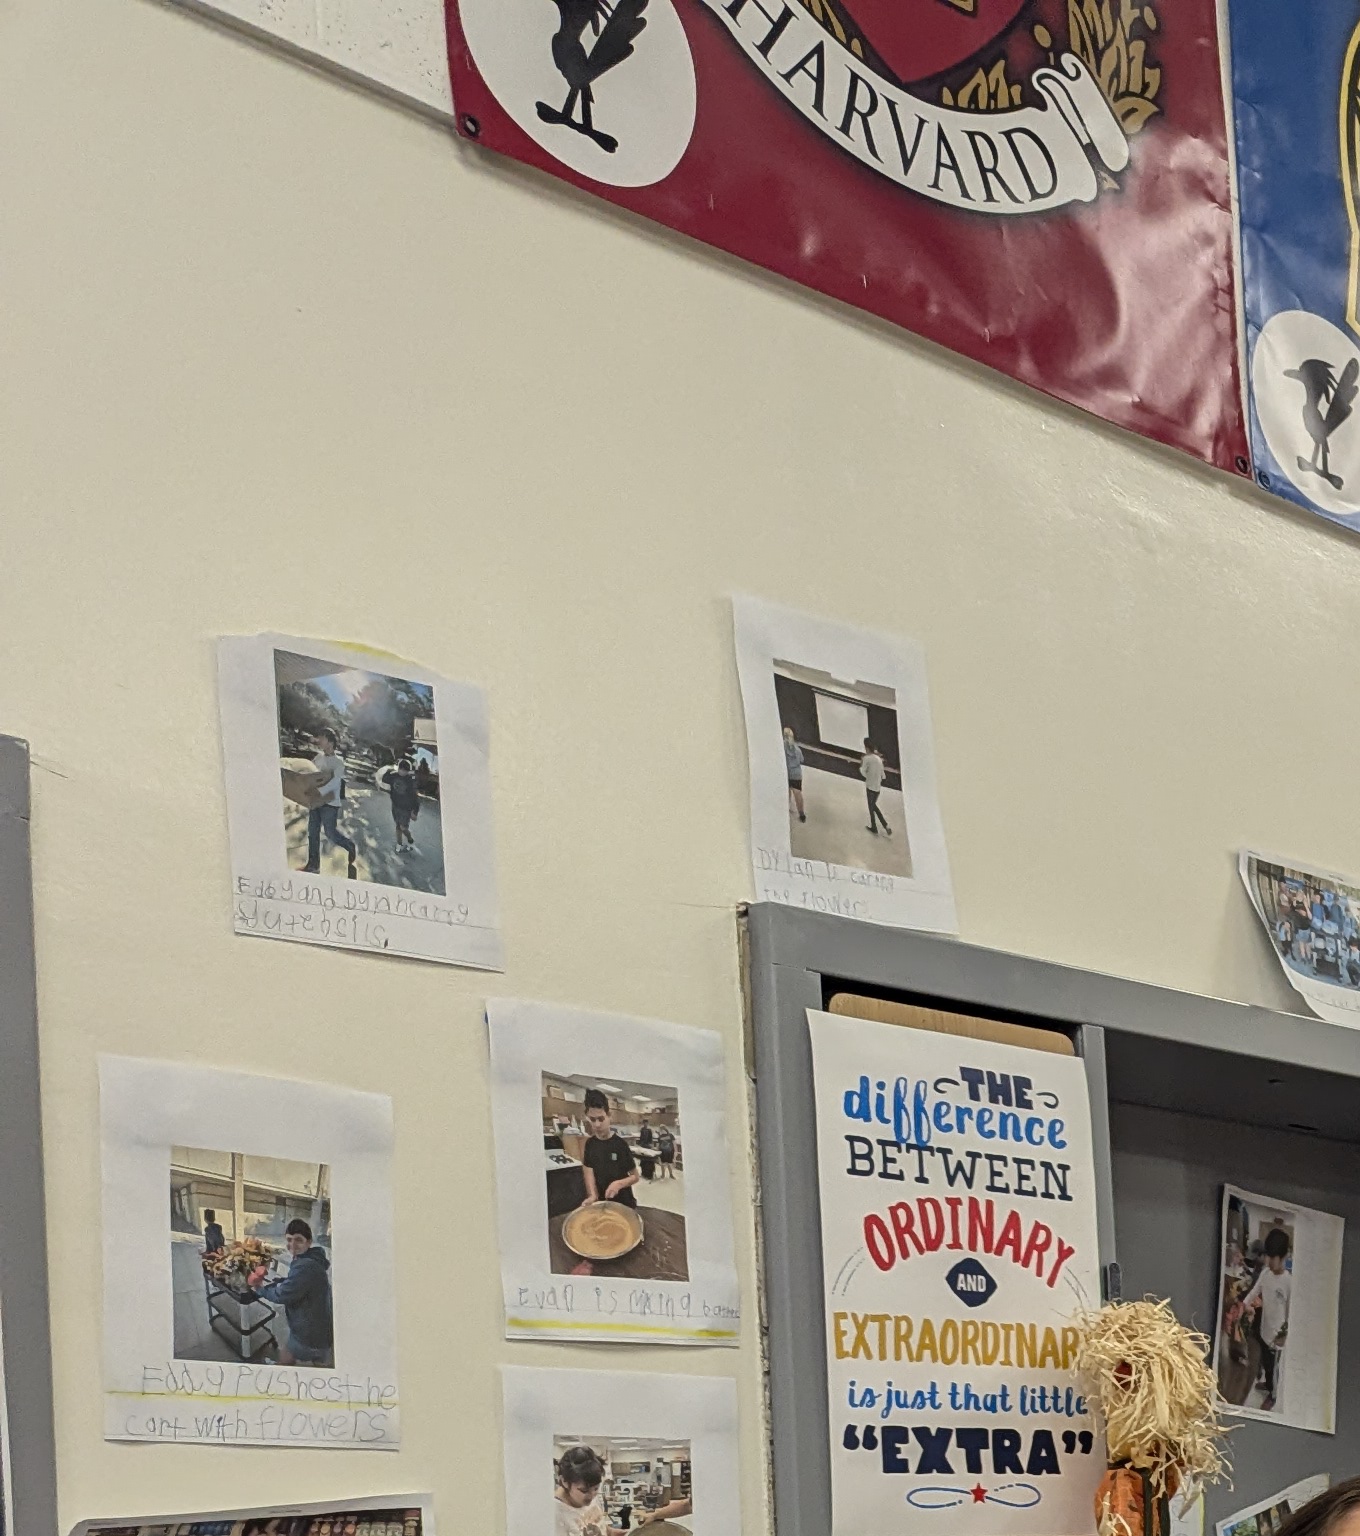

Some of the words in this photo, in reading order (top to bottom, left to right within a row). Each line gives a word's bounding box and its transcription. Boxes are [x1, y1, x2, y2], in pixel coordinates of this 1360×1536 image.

[727, 0, 1058, 203] HARVARD
[843, 1075, 1067, 1149] difference
[959, 1065, 1034, 1110] THE
[844, 1134, 1073, 1202] BETWEEN
[863, 1196, 1076, 1288] ORDINARY
[956, 1273, 987, 1294] AND
[833, 1311, 1080, 1371] EXTRAORDINAR
[848, 1380, 881, 1411] is
[881, 1381, 941, 1419] just
[947, 1380, 1013, 1416] that
[1020, 1381, 1088, 1418] little
